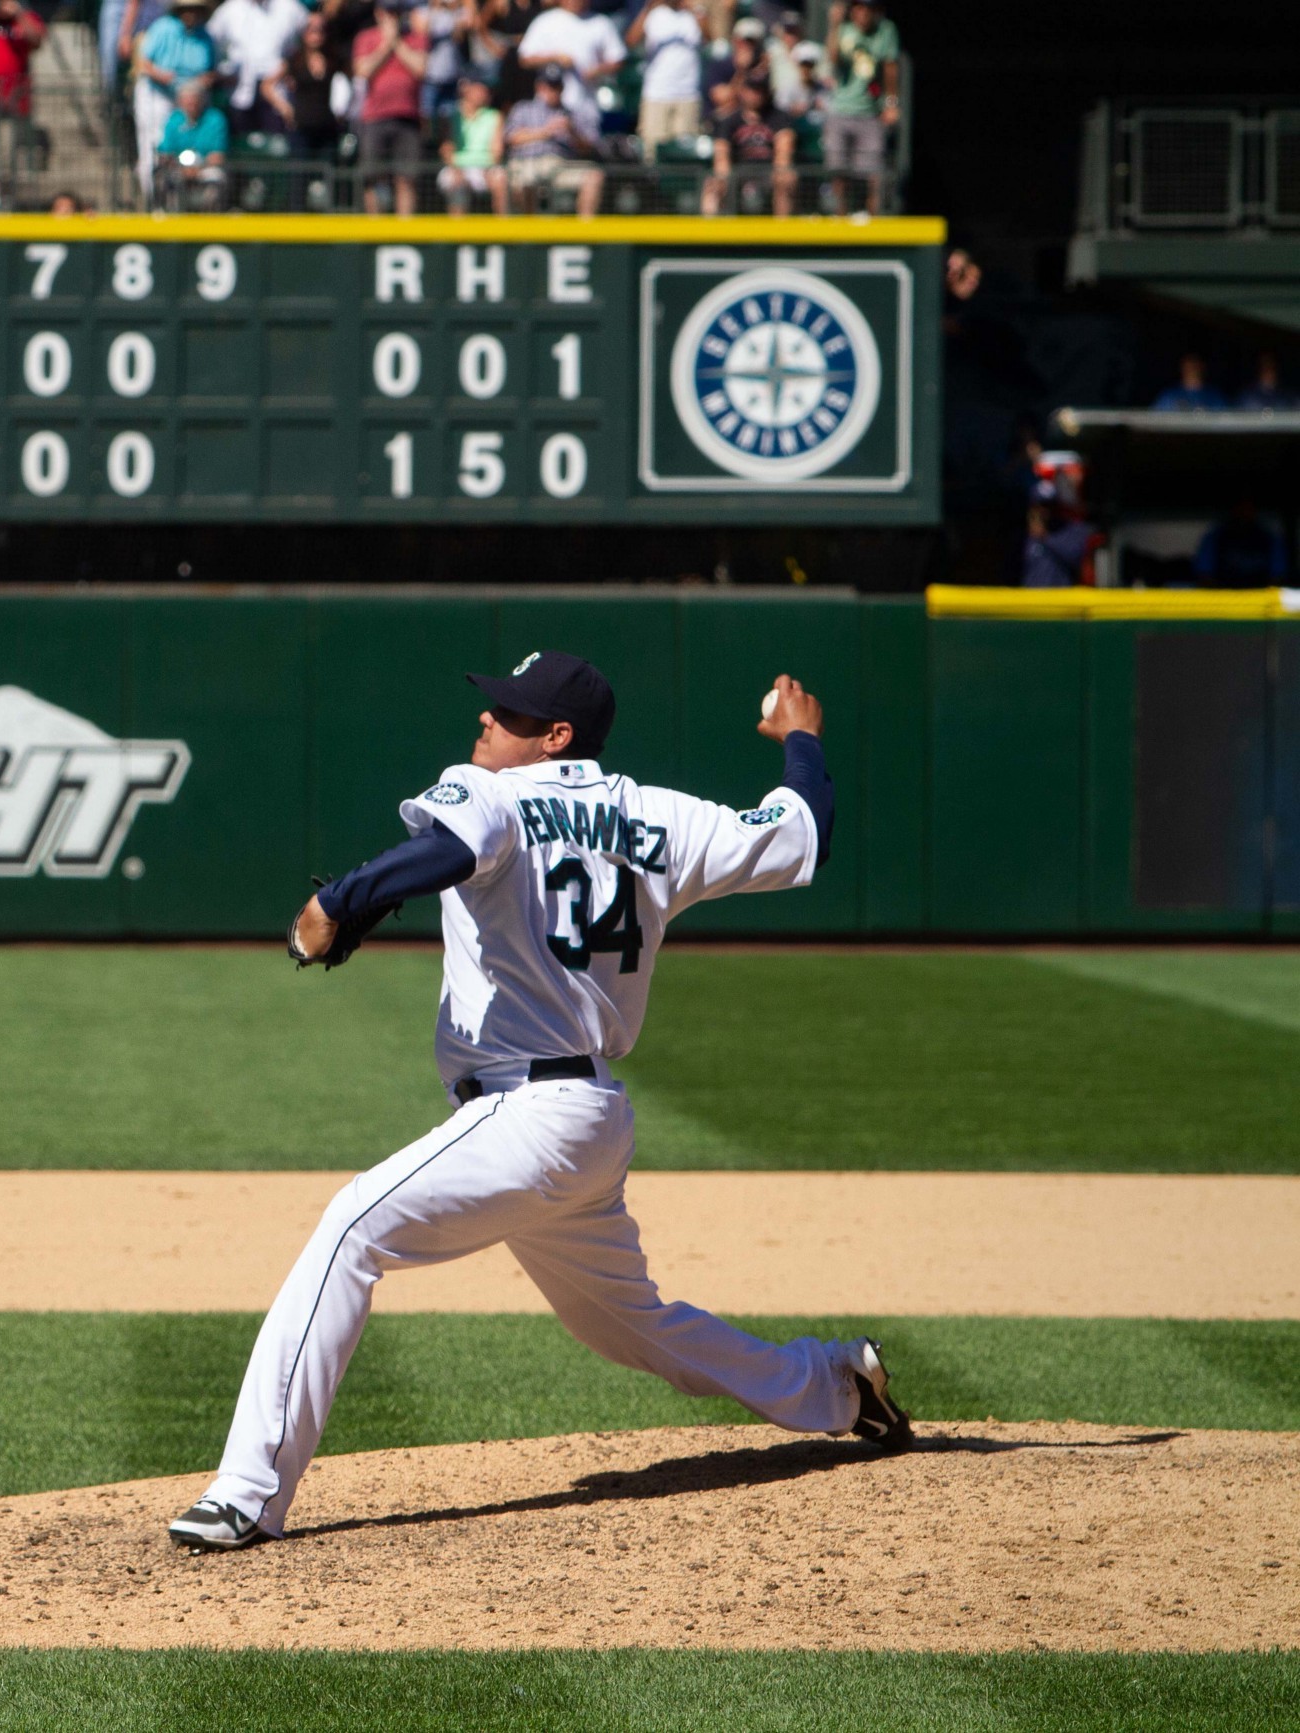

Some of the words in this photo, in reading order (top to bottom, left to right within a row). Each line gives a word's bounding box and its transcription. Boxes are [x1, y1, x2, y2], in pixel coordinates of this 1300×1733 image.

[25, 244, 67, 300] 7
[112, 244, 153, 300] 8
[196, 245, 236, 301] 9
[375, 246, 423, 302] R
[457, 246, 504, 302] H
[548, 246, 592, 303] E
[701, 291, 850, 358] SEATTLE
[23, 331, 71, 397] 0
[107, 332, 155, 397] 0
[373, 332, 420, 397] 0
[459, 334, 505, 399] 0
[552, 334, 580, 400] 1
[702, 387, 851, 457] MARINERS
[21, 431, 69, 496] 0
[107, 431, 154, 496] 0
[385, 432, 412, 498] 1
[459, 432, 505, 497] 5
[540, 433, 587, 498] 0
[544, 857, 644, 975] 34
